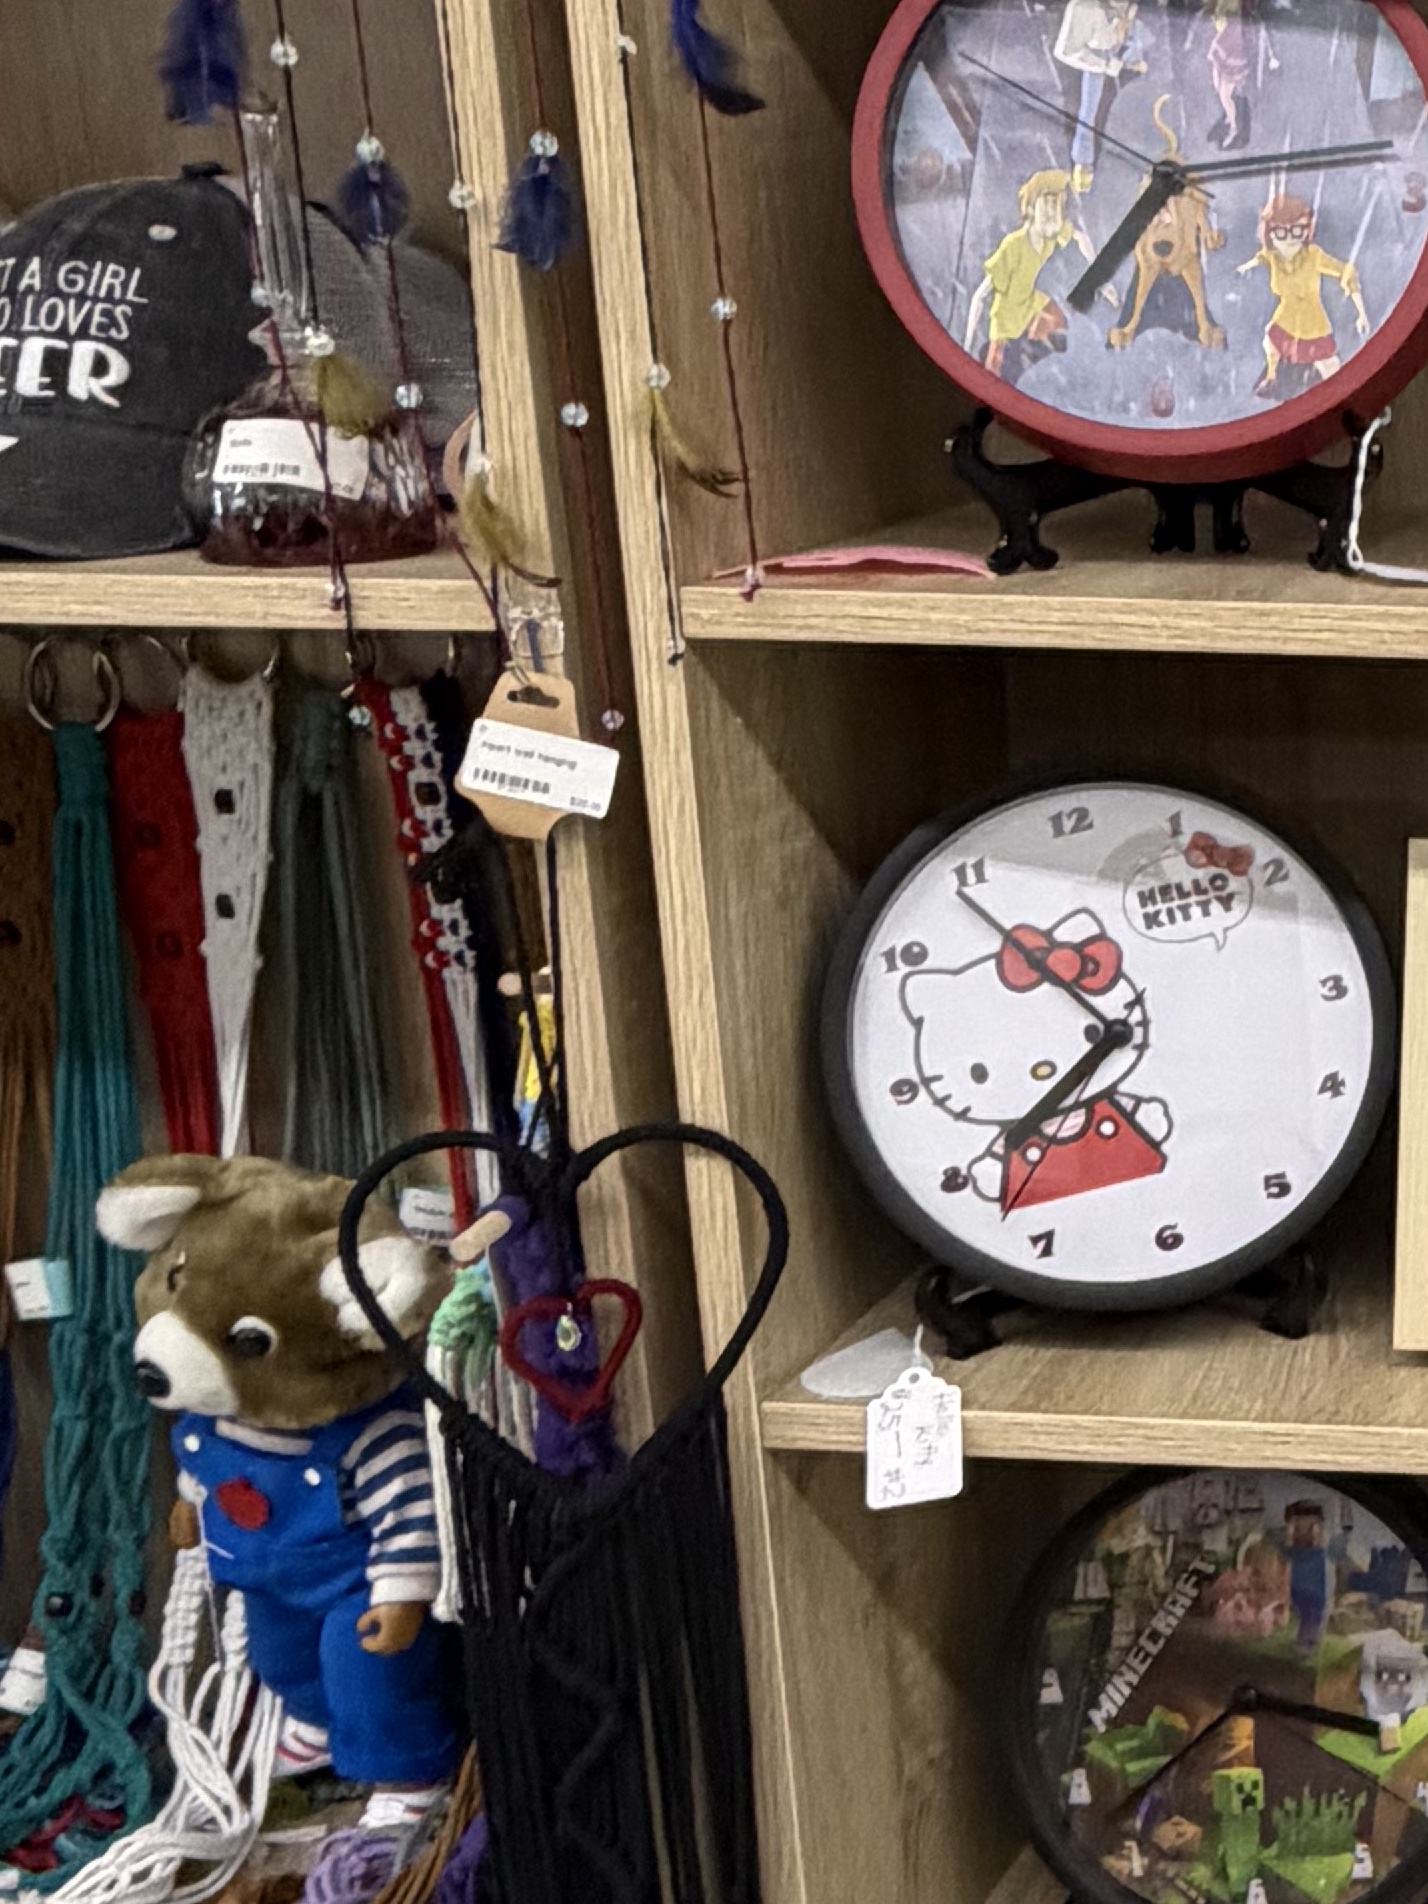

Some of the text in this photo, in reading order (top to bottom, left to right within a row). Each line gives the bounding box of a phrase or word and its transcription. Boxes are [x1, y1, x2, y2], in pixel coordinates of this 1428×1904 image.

[18, 256, 41, 292] A
[57, 260, 149, 303] GIRL
[21, 295, 132, 340] LOVES
[0, 337, 131, 407] ER
[1047, 806, 1094, 838] 12
[951, 857, 989, 889] 11
[1262, 858, 1290, 885] 2
[1137, 873, 1230, 908] HELLO
[1142, 892, 1236, 931] KITTY
[1320, 975, 1348, 1001] 3
[1263, 1173, 1292, 1199] 5
[1029, 1230, 1055, 1259] 7
[1155, 1224, 1184, 1250] 6
[1086, 1555, 1216, 1733] MINECRAFT
